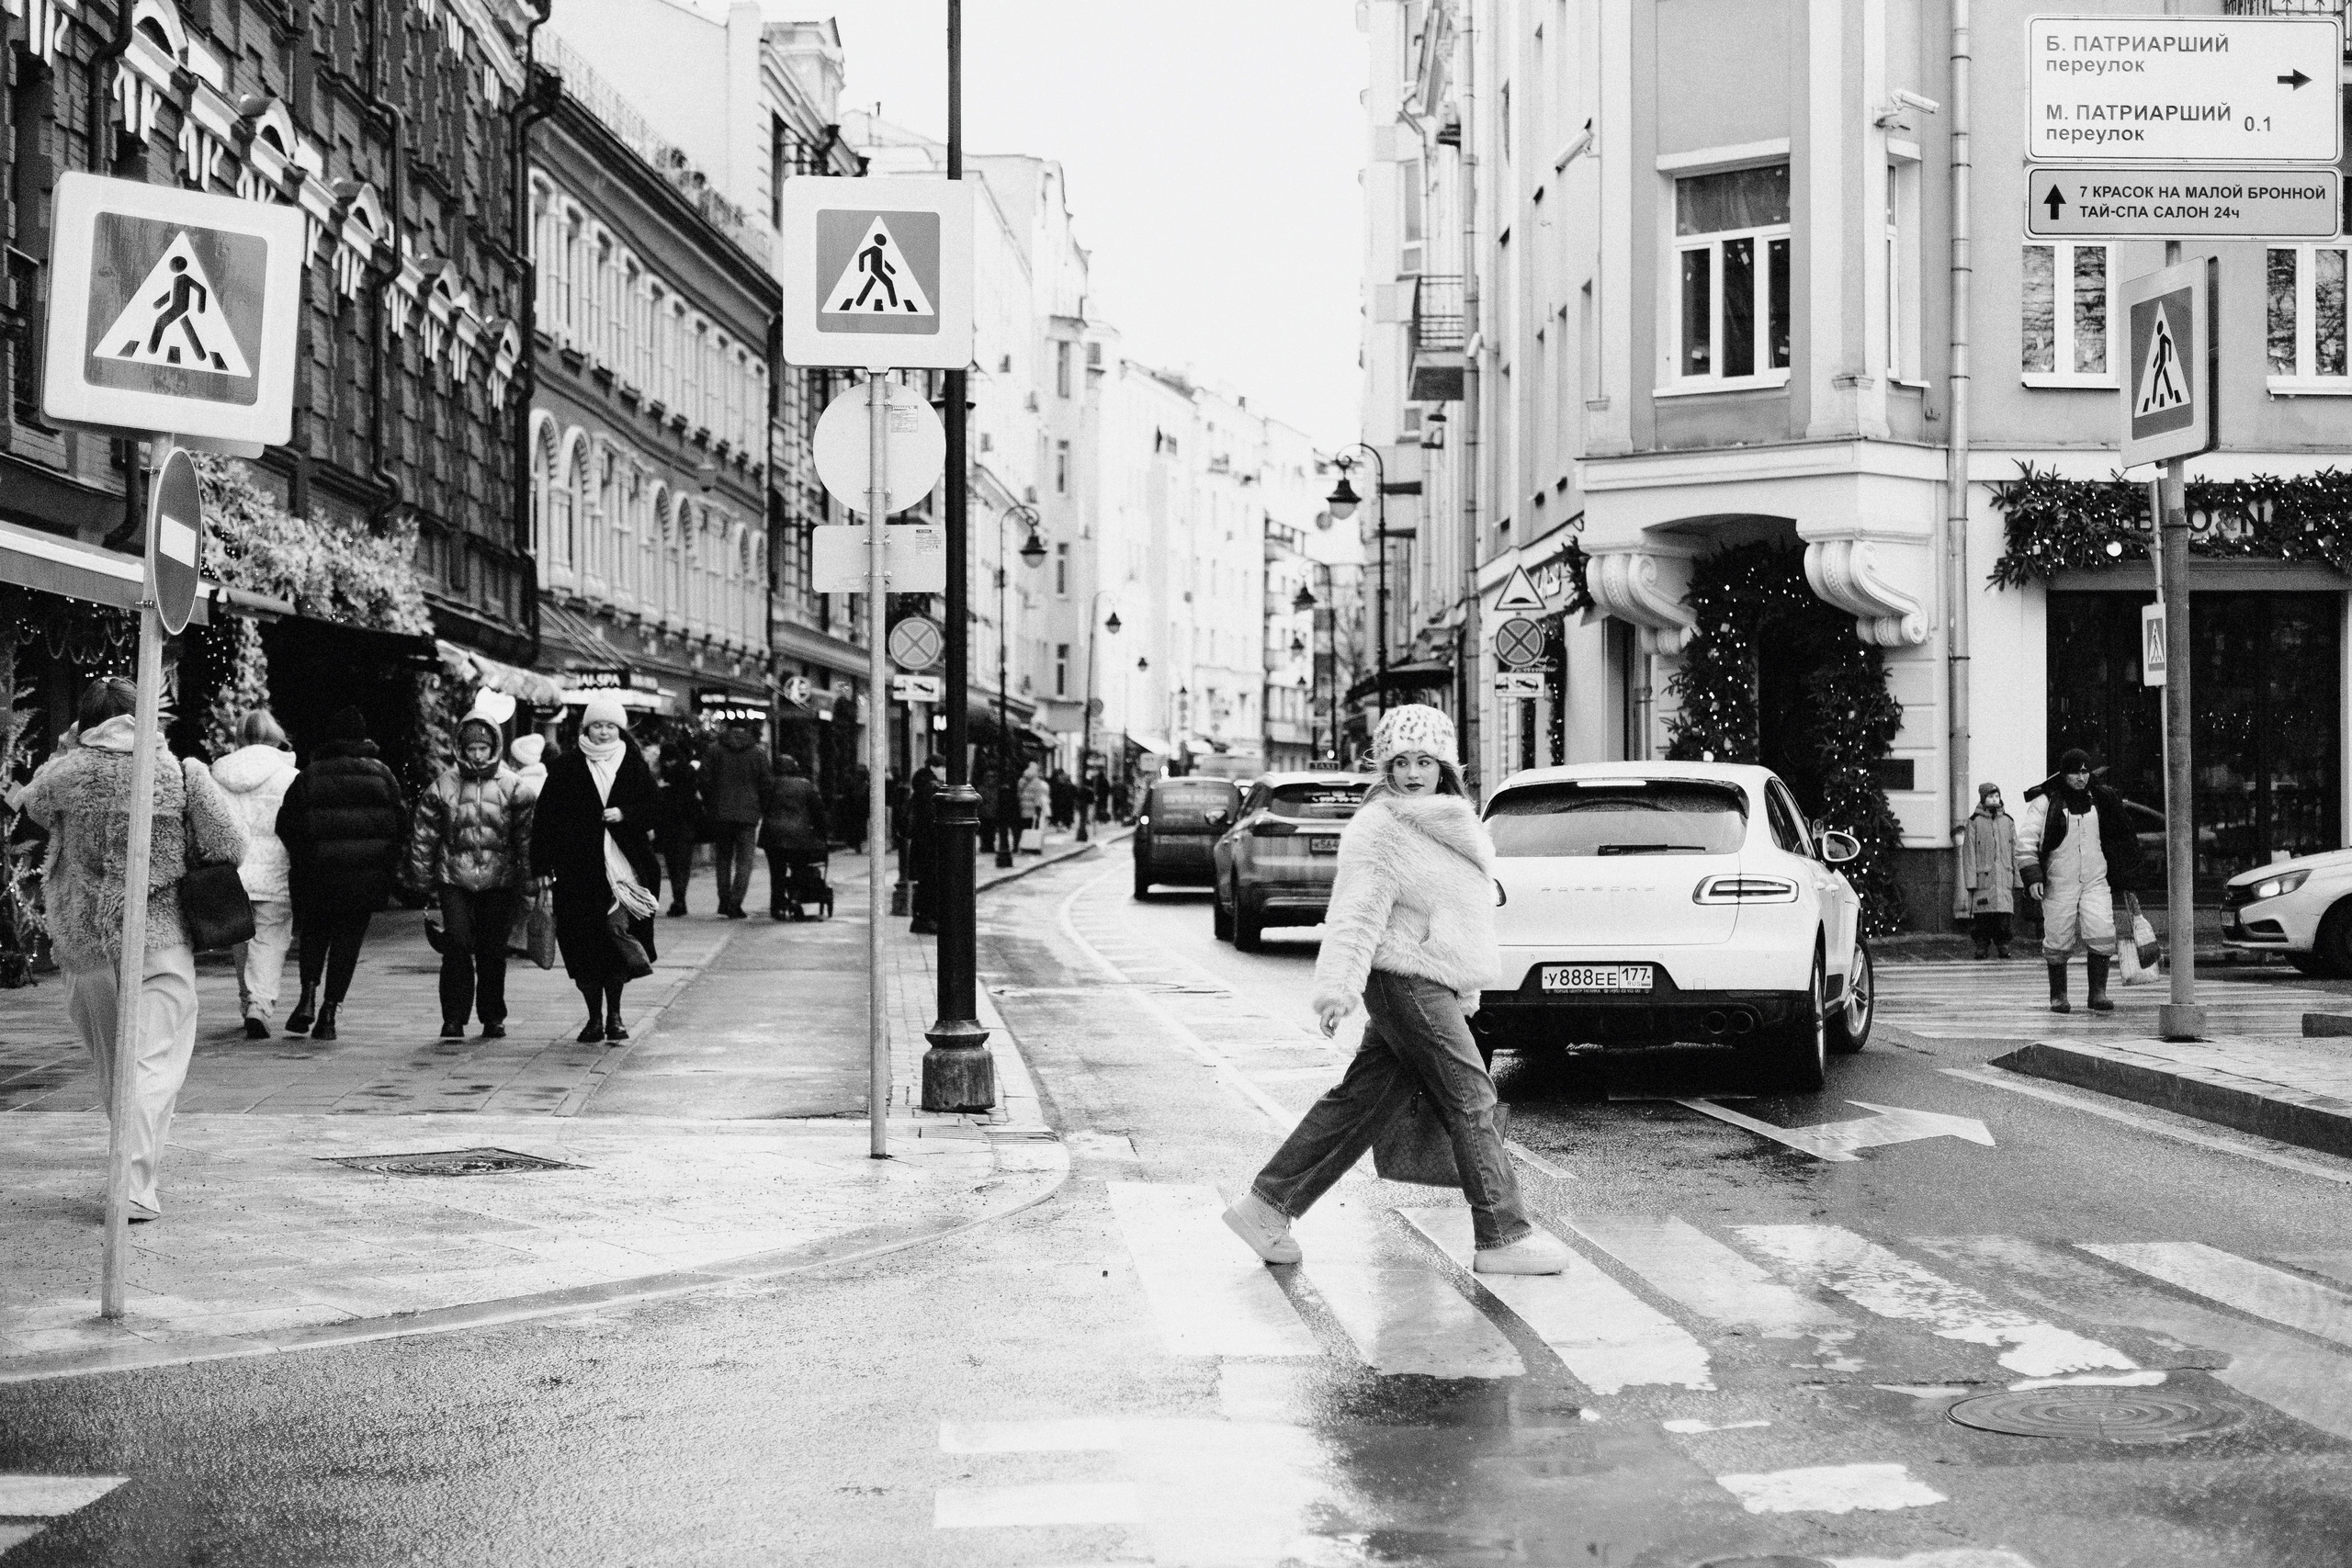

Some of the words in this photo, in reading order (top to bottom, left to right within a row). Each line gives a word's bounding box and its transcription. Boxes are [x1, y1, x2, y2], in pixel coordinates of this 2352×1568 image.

[2046, 35, 2065, 51] Б.
[2074, 33, 2229, 52] ПАТРИАРШИЙ
[2046, 60, 2145, 76] переулок
[2046, 104, 2068, 120] М.
[2076, 102, 2231, 121] ПАТРИАРШИЙ
[2244, 116, 2271, 132] 0.1
[2046, 128, 2145, 144] переулок
[2079, 186, 2087, 198] 7
[2093, 186, 2154, 198] КРАСОК
[2159, 186, 2180, 198] НА
[2185, 184, 2243, 199] МАЛОЙ
[2247, 185, 2326, 200] БРОННОЙ
[2079, 204, 2149, 219] ТАЙ-СПА
[2154, 206, 2210, 219] САЛОН
[2214, 207, 2240, 219] 24ч
[1622, 967, 1648, 981] 177
